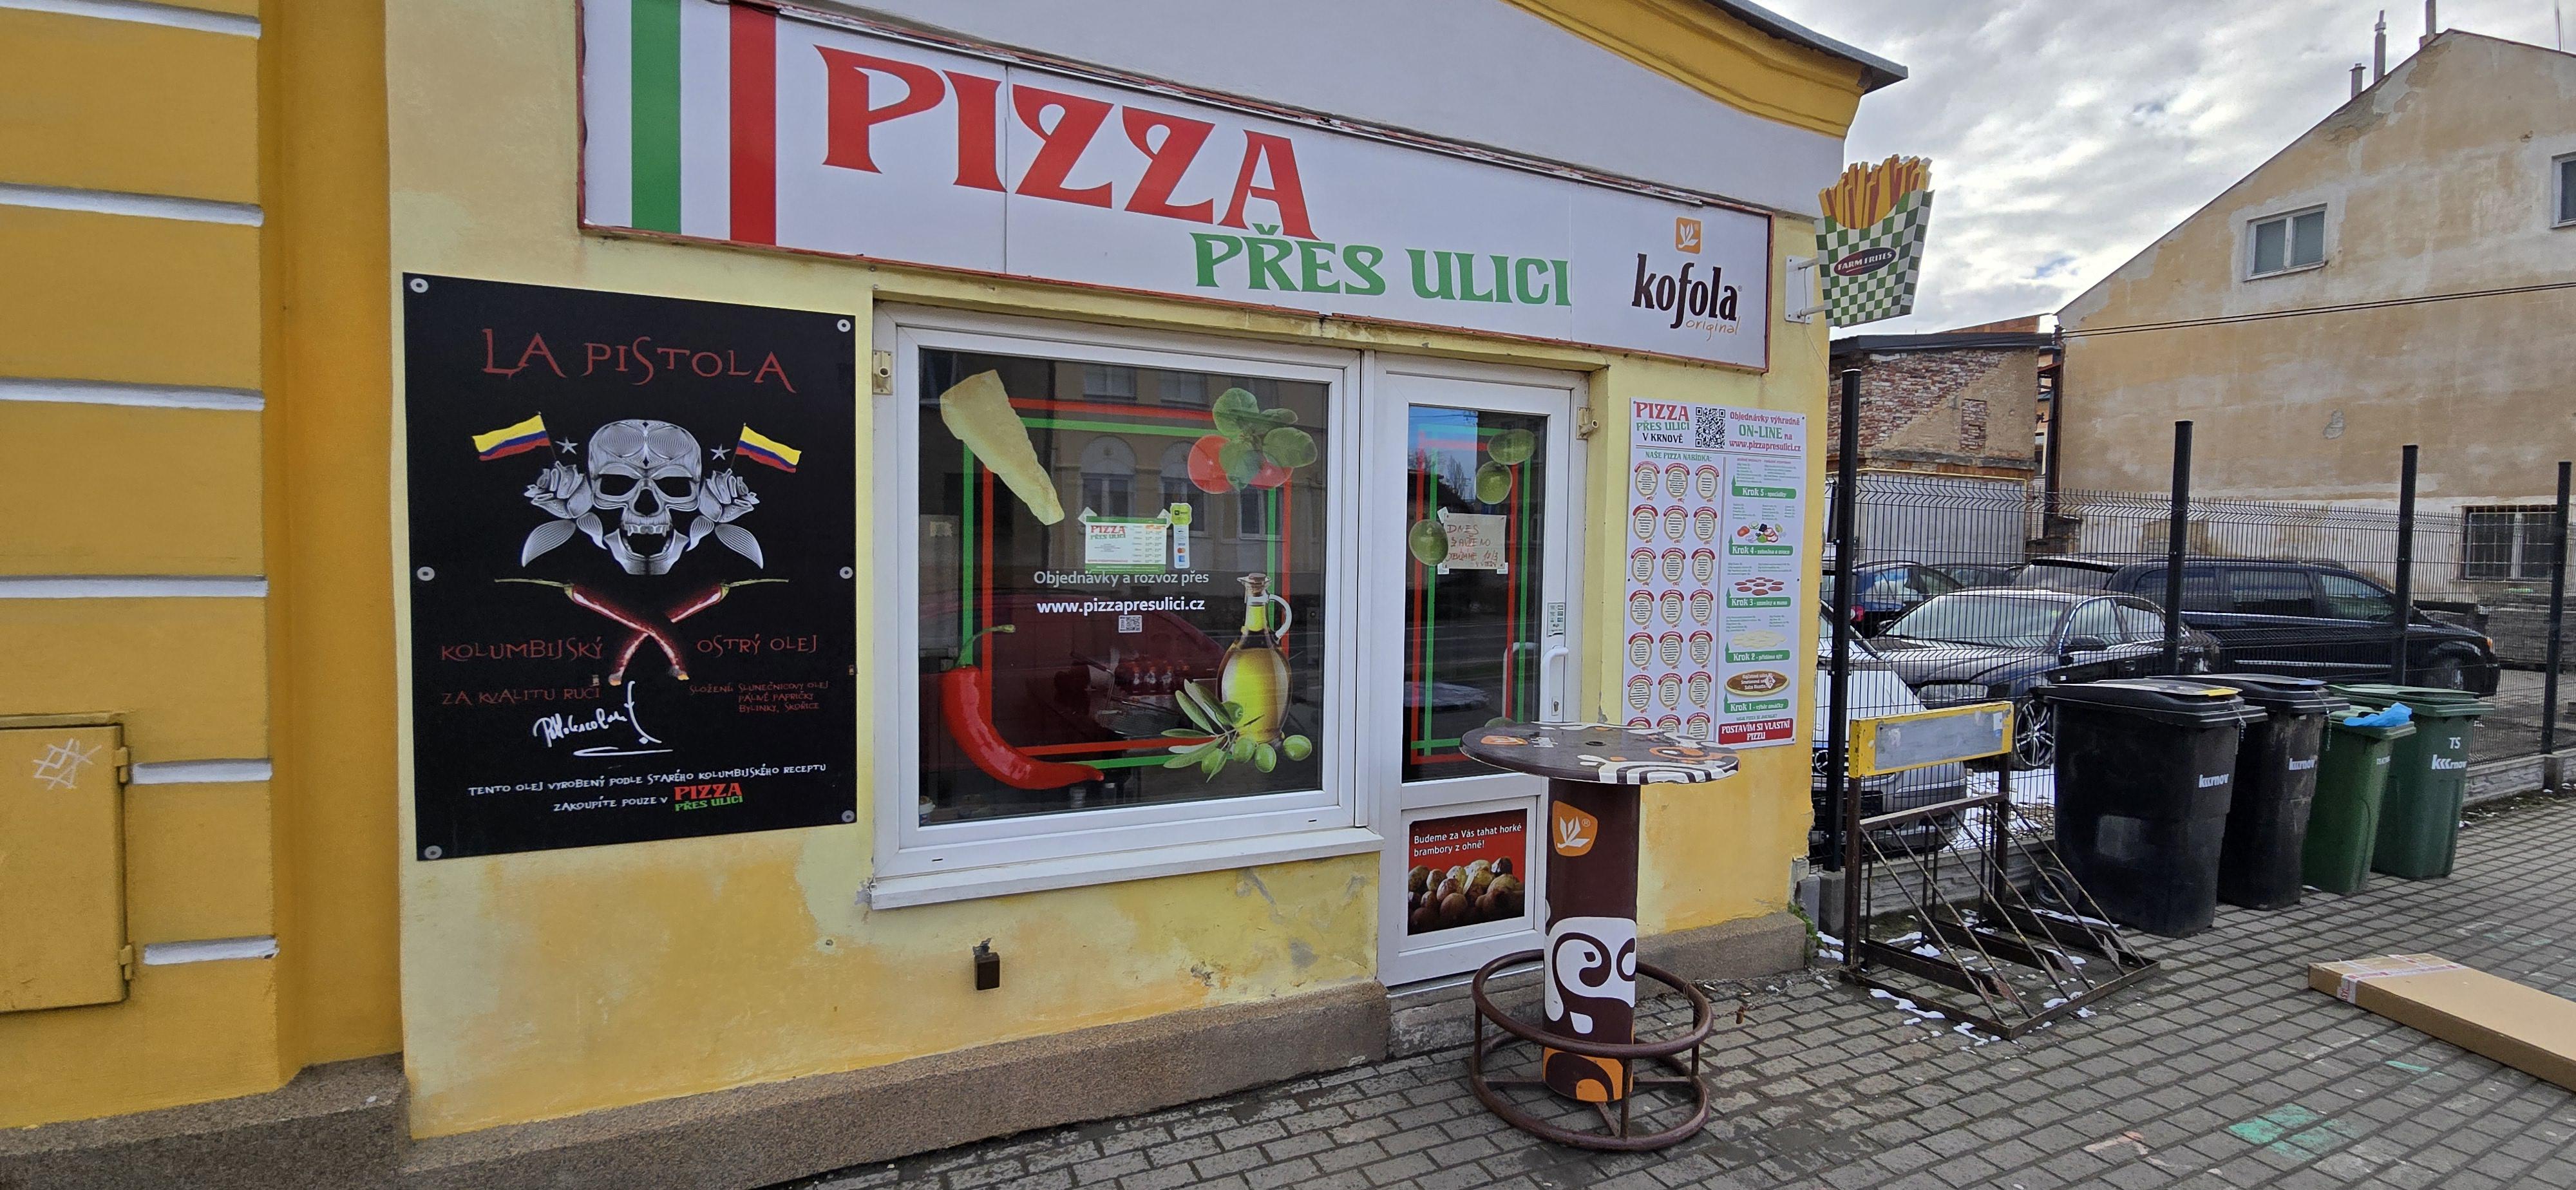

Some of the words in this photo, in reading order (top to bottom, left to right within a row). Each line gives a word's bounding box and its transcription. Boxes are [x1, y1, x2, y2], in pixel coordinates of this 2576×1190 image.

[813, 44, 1321, 240] PIZZA
[1190, 223, 1387, 296] PŘES
[1406, 249, 1572, 306] ULICI
[1837, 259, 1862, 271] FARM
[1864, 251, 1892, 266] FRITES
[1632, 252, 1738, 329] kofola
[1685, 316, 1741, 341] original
[480, 328, 567, 380] LA
[580, 336, 797, 394] PISTOLA
[1635, 401, 1690, 422] PIZZA
[1730, 411, 1769, 424] Objednávky
[1770, 415, 1800, 426] výhradně
[1636, 420, 1662, 431] PŘES
[1664, 421, 1690, 431] ULICI
[1739, 424, 1783, 439] ON-LINE
[1642, 432, 1649, 441] V
[1651, 433, 1683, 444] KRNOVĚ
[1729, 440, 1801, 452] www.pizzapresulici.cz
[1645, 451, 1663, 459] NAŠE
[1663, 452, 1681, 460] PIZZA
[1683, 452, 1712, 462] NABÍDKA:
[1742, 487, 1759, 496] Krok
[1090, 525, 1126, 534] PIZZA
[1446, 524, 1479, 535] DNES
[1034, 570, 1119, 587] Objednávky
[1122, 574, 1131, 583] a
[1134, 573, 1178, 583] rozvoz
[1181, 570, 1209, 586] přes
[1036, 596, 1206, 616] www.pizzapresulici.cz
[442, 636, 603, 661] KOLUMBIJSKÝ
[697, 634, 761, 658] OSTRÝ
[770, 634, 817, 653] OLEJ
[806, 680, 829, 689] OLEJ
[442, 690, 473, 705] ZA
[478, 688, 556, 704] KVALITU
[1730, 703, 1747, 712] Krok
[1721, 722, 1756, 734] POSTAVÍM
[1756, 723, 1764, 732] SI
[1765, 719, 1790, 730] VLASTNÍ
[1747, 732, 1766, 741] PIZZU
[2448, 736, 2461, 749] TS
[468, 785, 511, 796] TENTO
[516, 781, 544, 792] OLEJ
[547, 775, 606, 791] VYROBENÝ
[609, 776, 643, 787] PODLE
[647, 770, 694, 786] STARÉHO
[698, 763, 779, 780] KOLUMBIJSKÉHO
[783, 764, 827, 774] RECEPTU
[674, 782, 743, 800] PIZZA
[553, 796, 617, 812] ZAKOUPÍTE
[621, 797, 657, 808] POUZE
[675, 800, 708, 811] PŘES
[710, 796, 744, 807] ULICI
[1414, 833, 1447, 844] Budeme
[1461, 829, 1475, 838] Vás
[1477, 826, 1498, 836] tahat
[1499, 823, 1522, 833] horké
[1414, 844, 1452, 857] brambory
[1462, 840, 1485, 851] ohně!
